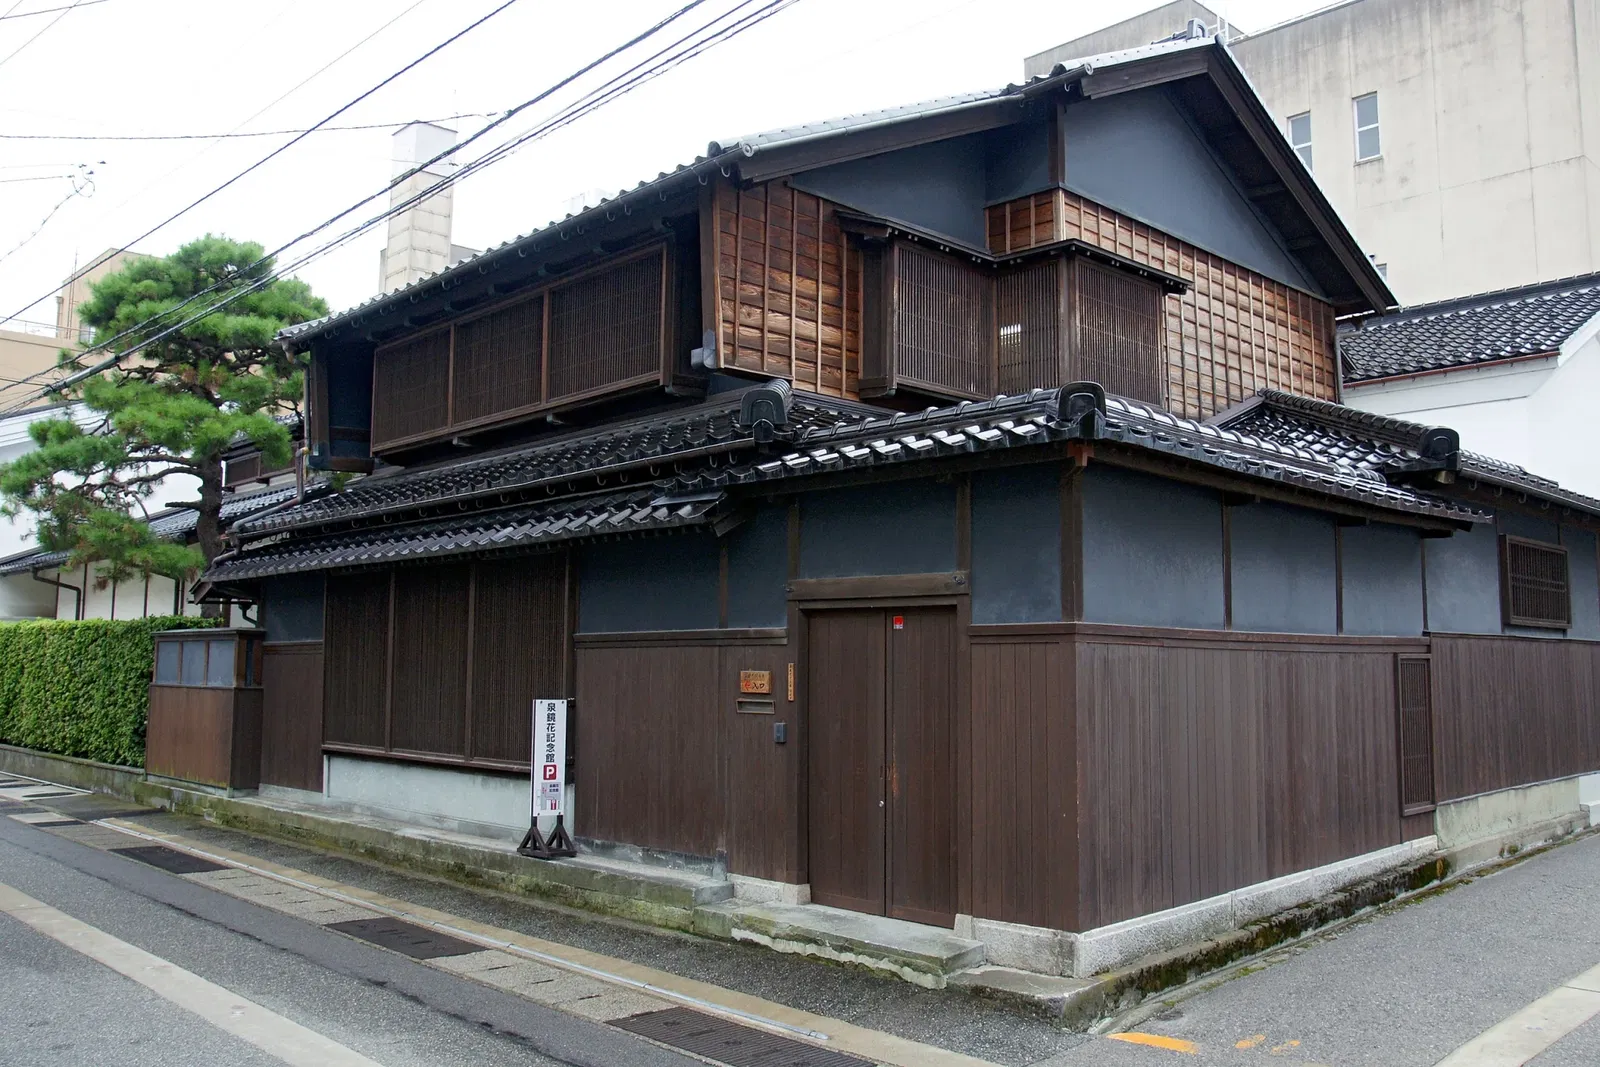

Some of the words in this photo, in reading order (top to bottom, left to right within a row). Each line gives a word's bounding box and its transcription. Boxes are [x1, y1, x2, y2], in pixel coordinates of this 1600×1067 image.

[752, 682, 765, 690] 入口
[545, 702, 556, 763] 泉鏡花記念館
[545, 767, 555, 779] P
